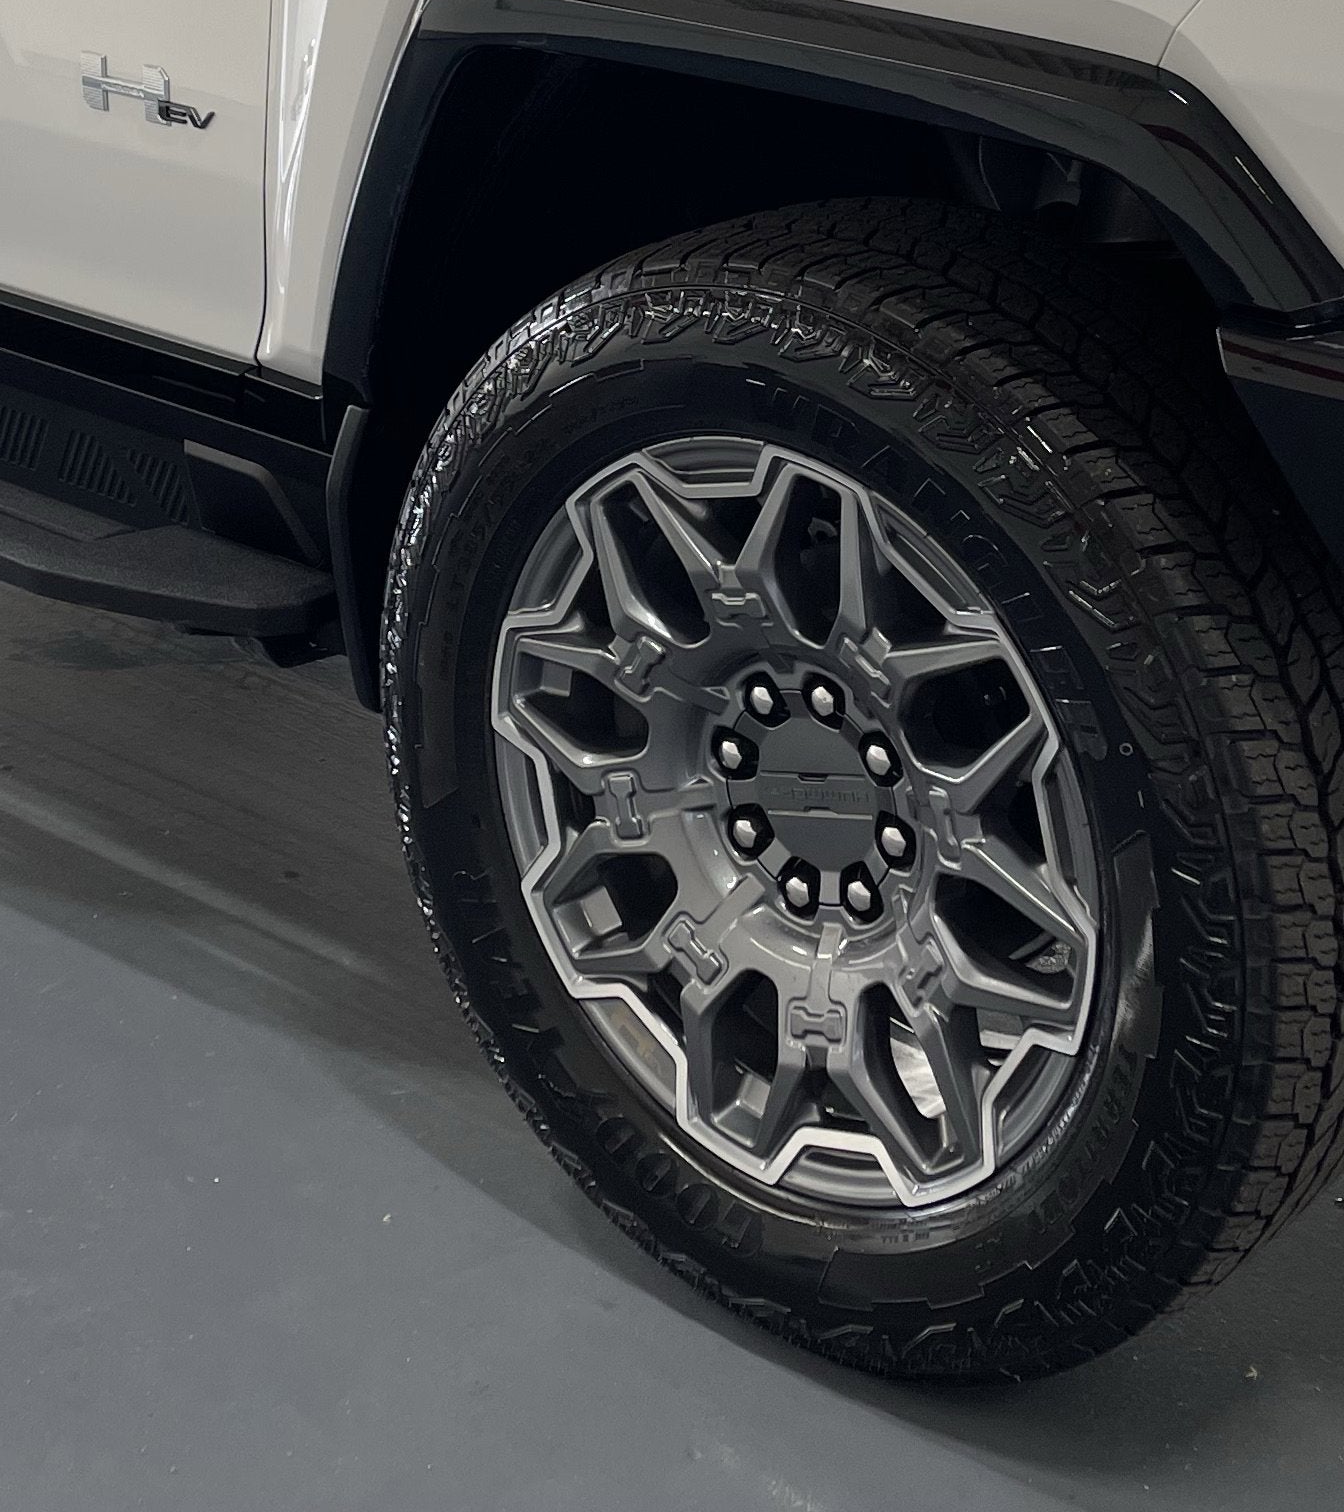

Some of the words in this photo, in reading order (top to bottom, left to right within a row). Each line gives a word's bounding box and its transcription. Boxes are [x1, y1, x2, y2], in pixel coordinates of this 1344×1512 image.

[156, 99, 216, 129] EV
[745, 377, 1108, 760] WRANGLER
[452, 868, 763, 1258] GOODYEAR
